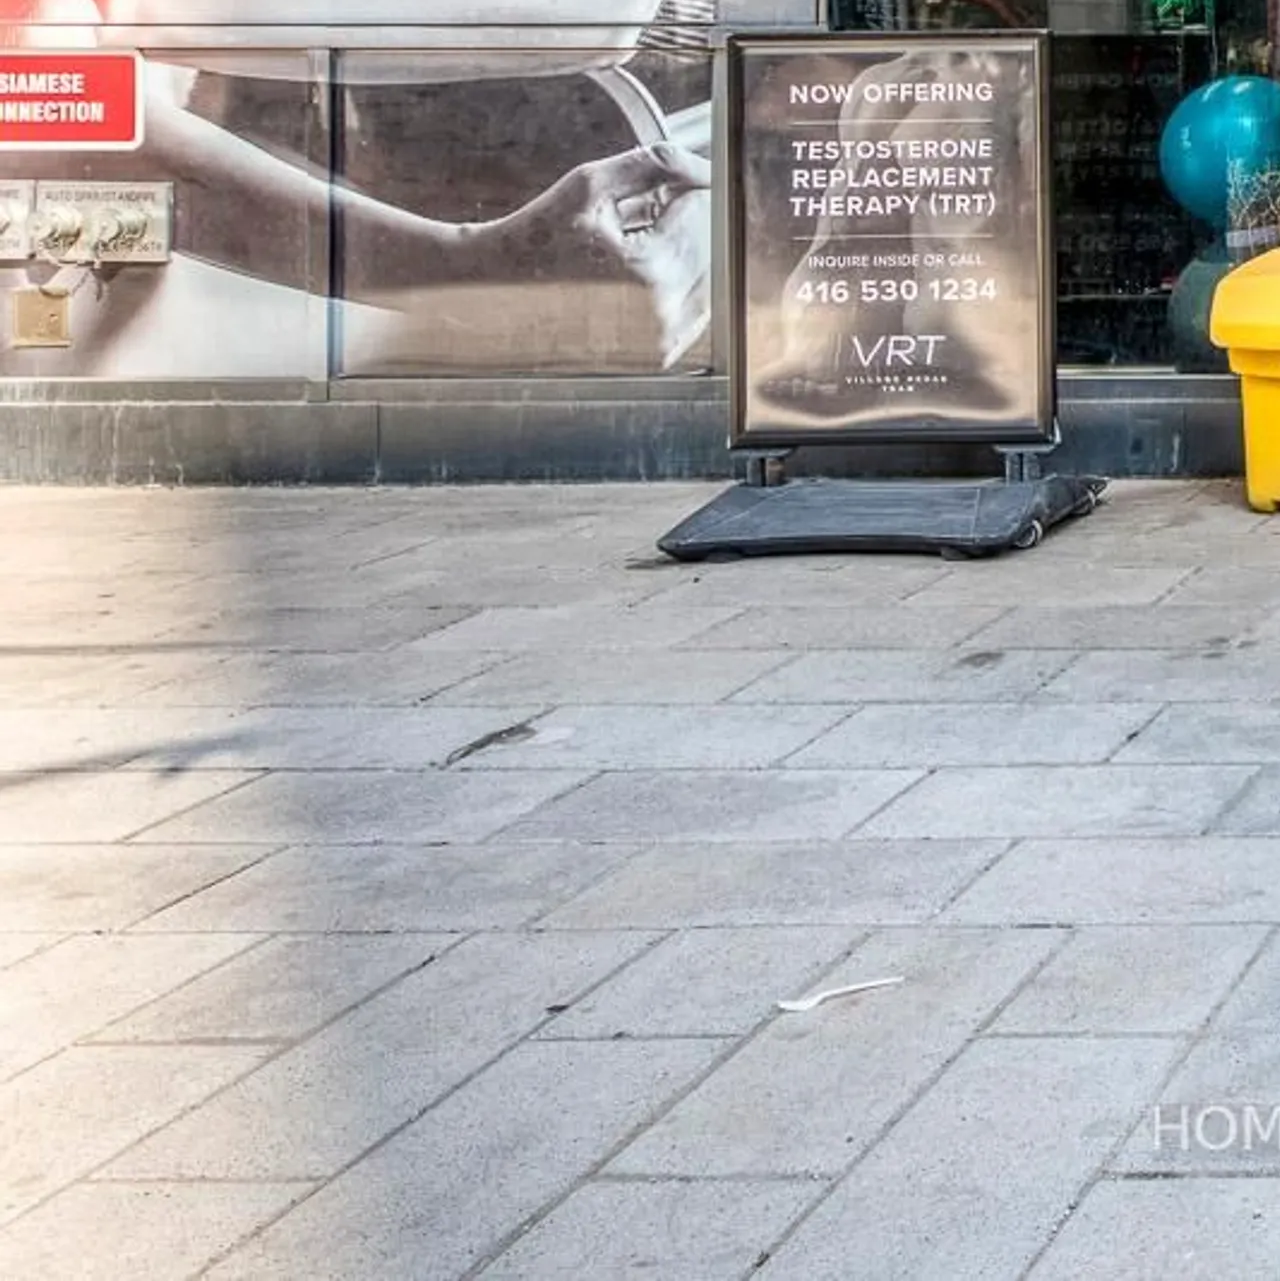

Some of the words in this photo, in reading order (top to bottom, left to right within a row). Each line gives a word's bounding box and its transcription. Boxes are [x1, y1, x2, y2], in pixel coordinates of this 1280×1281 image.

[0, 73, 85, 95] SIAMESE
[789, 83, 853, 105] NOW
[863, 82, 994, 104] OFFERING
[0, 101, 105, 124] NNECTION
[791, 139, 994, 161] TESTOSTERONE
[792, 166, 993, 189] REPLACEMENT
[789, 194, 920, 217] THERAPY
[929, 191, 996, 217] (TRT)
[808, 254, 869, 268] INQUIRE
[873, 254, 919, 268] INSIDE
[923, 254, 945, 266] OR
[948, 253, 984, 266] CALL
[796, 280, 850, 304] 416
[861, 279, 919, 303] 530
[929, 277, 998, 302] 1234
[851, 334, 947, 368] VRT
